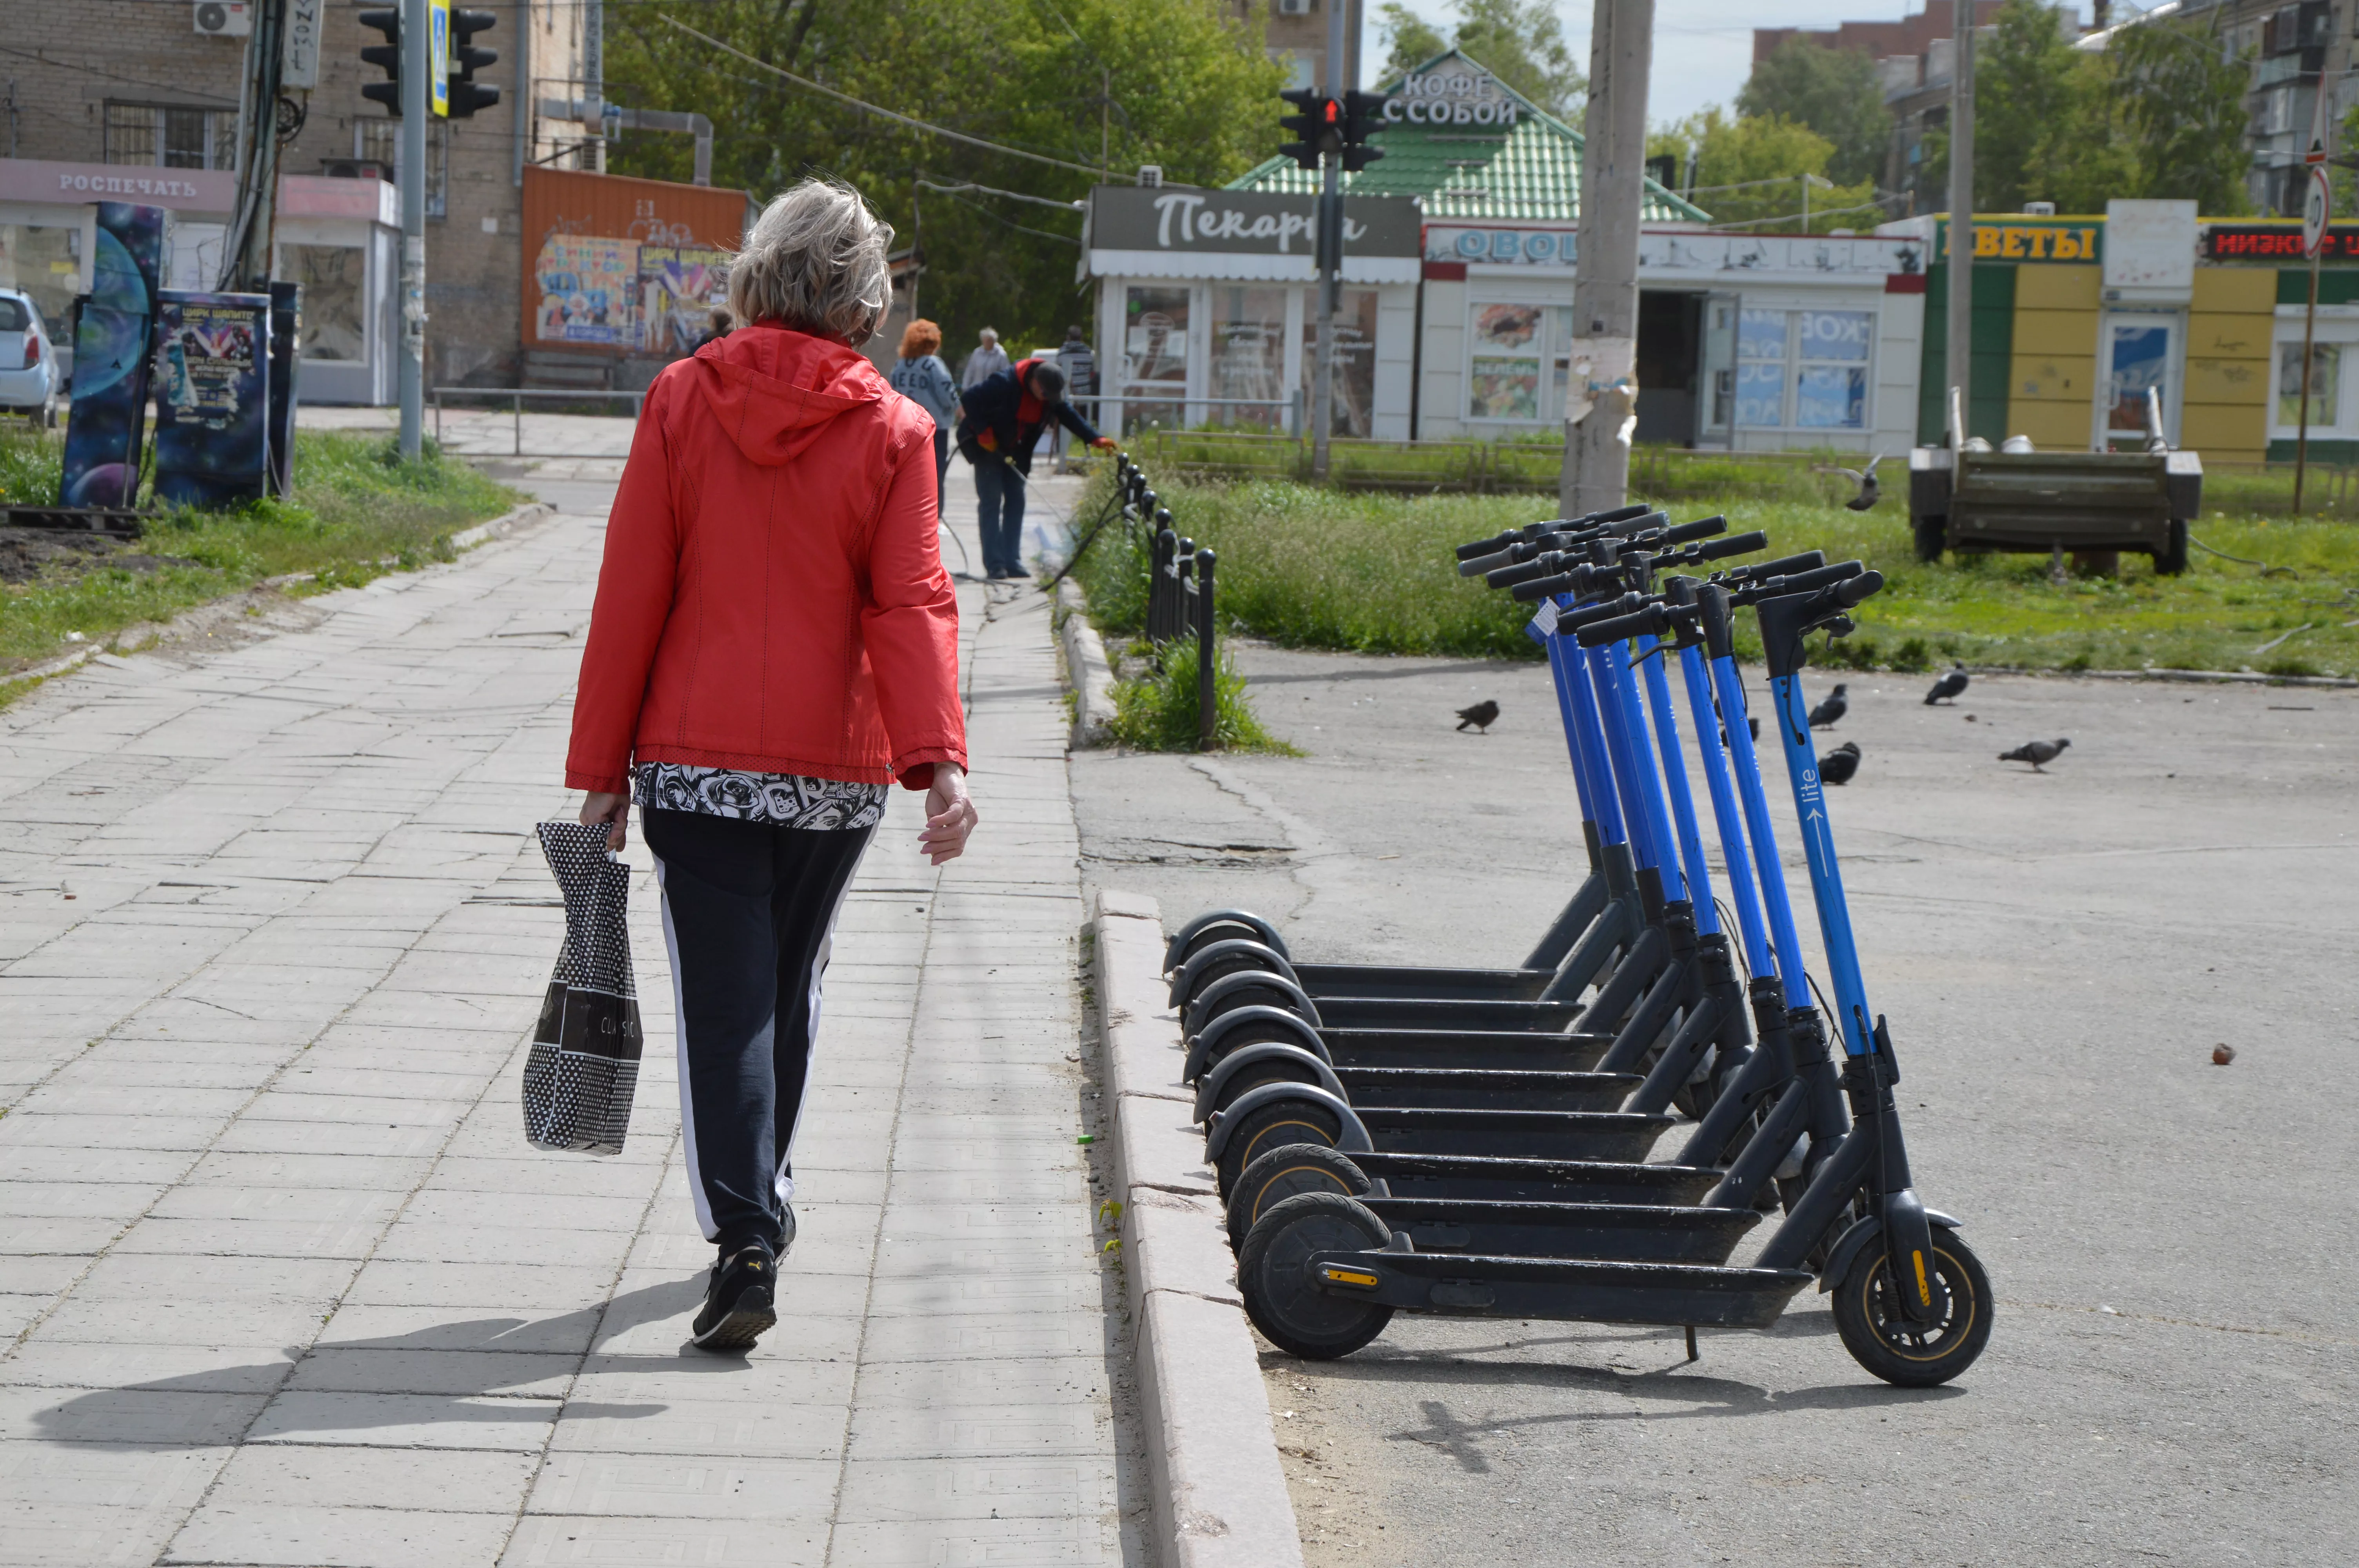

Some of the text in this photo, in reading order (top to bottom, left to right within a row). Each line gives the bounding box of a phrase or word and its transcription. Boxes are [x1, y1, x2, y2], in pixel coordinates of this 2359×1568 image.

[1404, 73, 1492, 98] КОФЕ
[60, 174, 197, 196] РОСПЕЧАТЬ
[1943, 226, 2096, 259] ВЕТЫ
[894, 357, 935, 371] OU
[1801, 769, 1819, 802] lite
